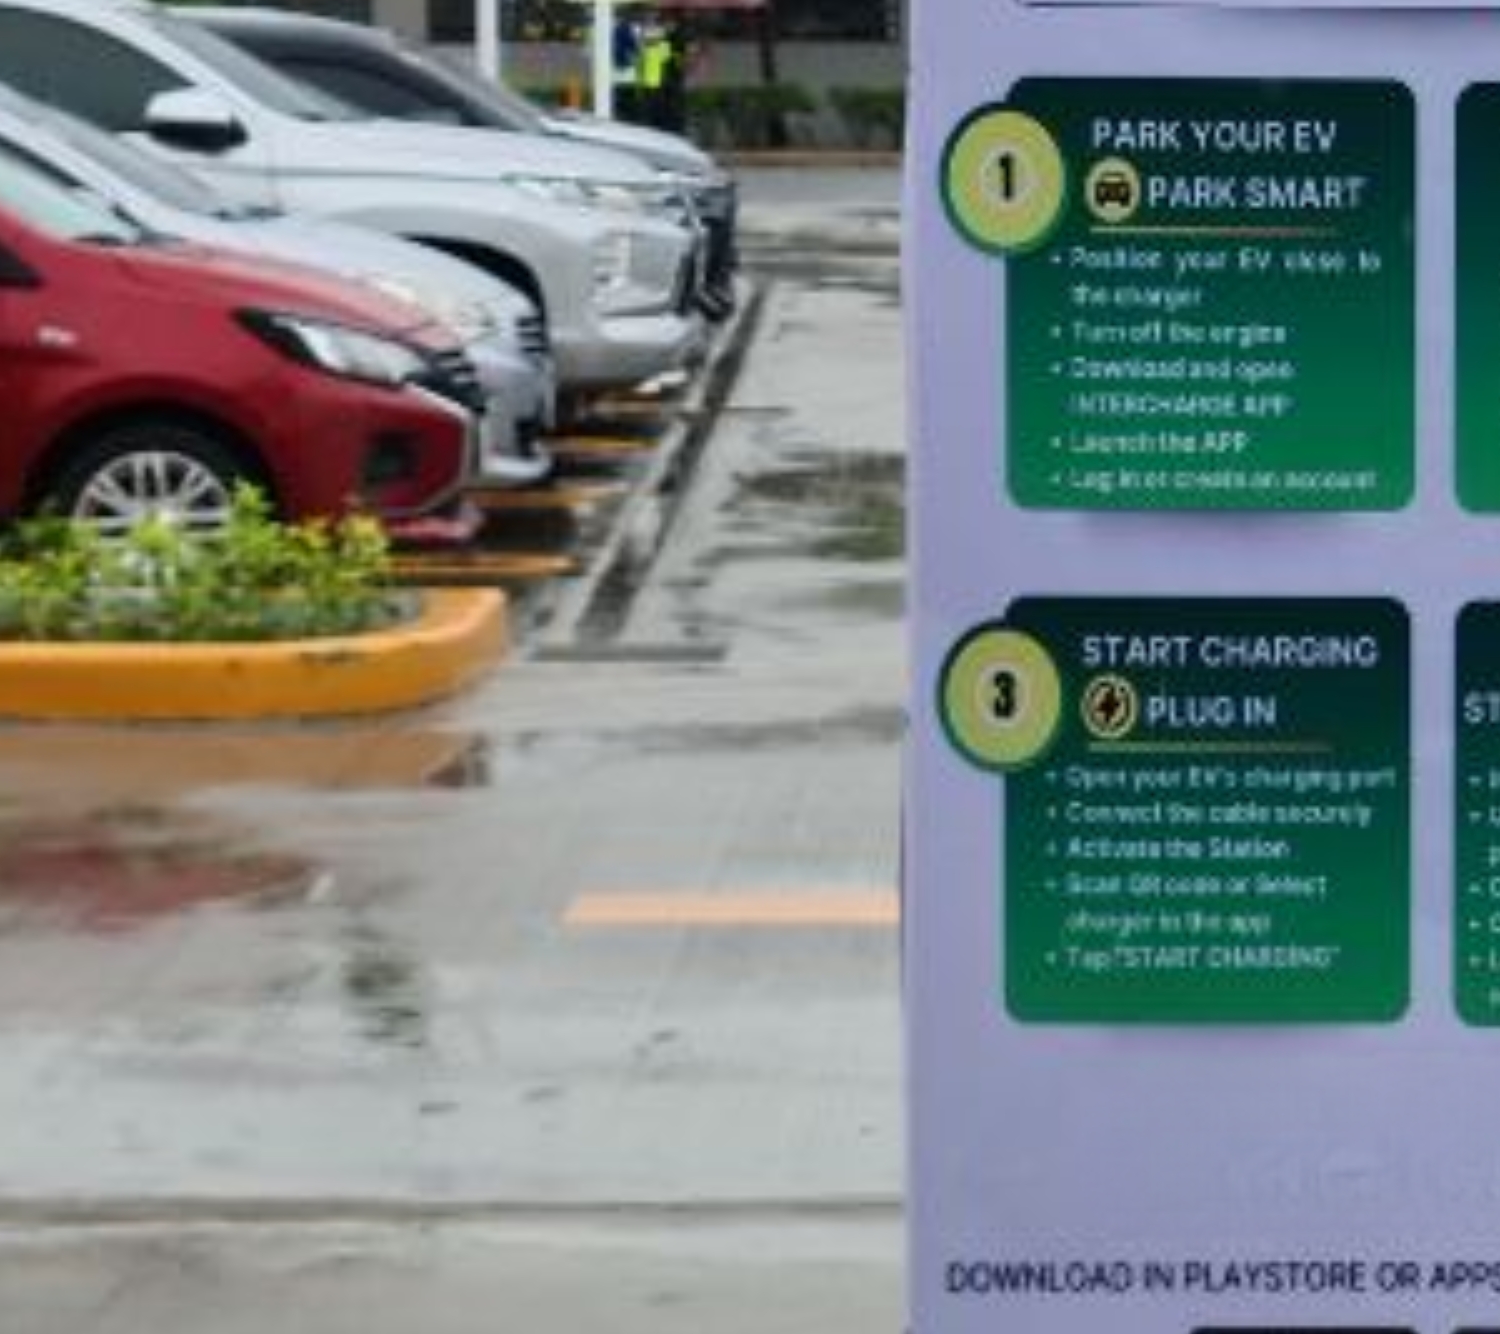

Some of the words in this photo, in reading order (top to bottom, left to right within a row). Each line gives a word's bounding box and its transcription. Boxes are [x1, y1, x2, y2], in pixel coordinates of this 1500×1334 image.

[1093, 120, 1181, 151] PARK
[1190, 121, 1286, 152] YOUR
[1294, 121, 1337, 152] EV
[998, 154, 1014, 201] 1
[1149, 177, 1236, 208] PARK
[1245, 176, 1367, 208] SMART
[1238, 249, 1271, 269] EV
[1359, 250, 1382, 269] to
[1072, 322, 1125, 344] Turn
[1128, 322, 1162, 344] off
[1169, 323, 1206, 344] the
[1070, 357, 1186, 379] Download
[1243, 395, 1293, 416] APP
[1158, 431, 1197, 452] the
[1202, 431, 1249, 453] APP
[1082, 636, 1192, 667] START
[1199, 636, 1378, 668] CHARGING
[992, 672, 1016, 718] 3
[1146, 695, 1237, 726] PLUG
[1244, 696, 1277, 726] IN
[1065, 767, 1127, 791] Open
[1132, 771, 1182, 793] your
[1065, 801, 1162, 823] Connect
[1166, 802, 1201, 823] the
[1163, 837, 1203, 858] the
[1208, 837, 1289, 858] Station
[946, 1262, 1133, 1294] DOWNLOAD
[1144, 1262, 1176, 1293] IN
[1184, 1262, 1367, 1293] PLAYSTORE
[1376, 1262, 1420, 1293] OR
